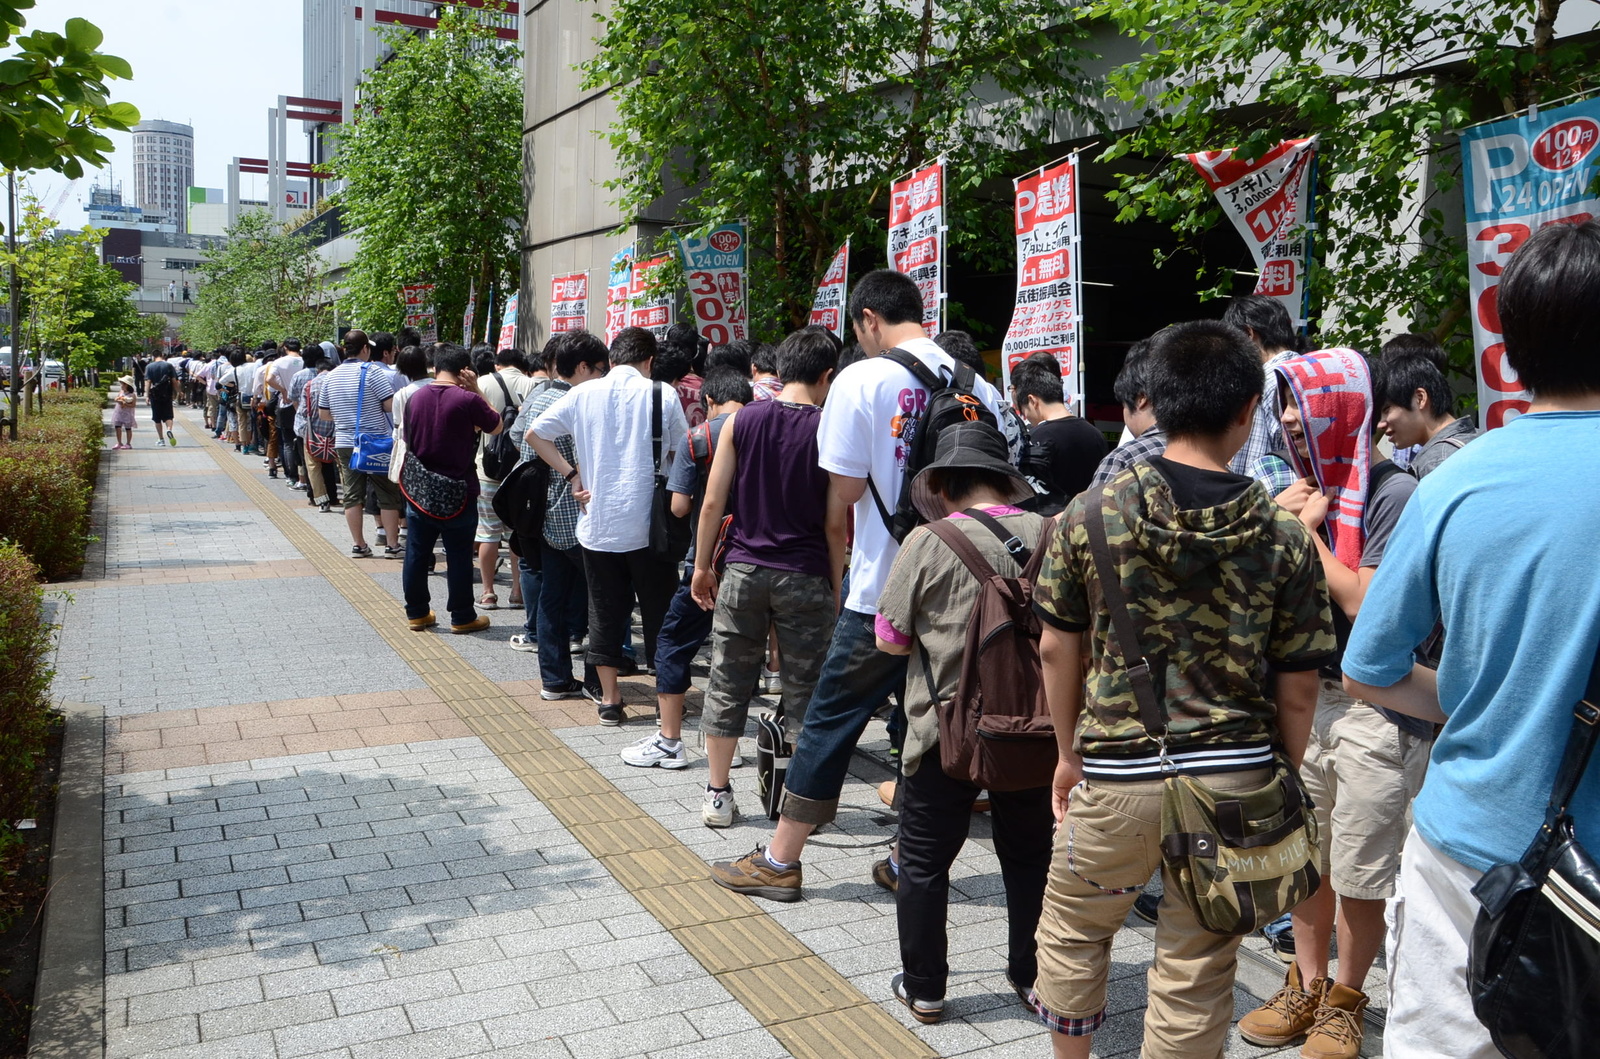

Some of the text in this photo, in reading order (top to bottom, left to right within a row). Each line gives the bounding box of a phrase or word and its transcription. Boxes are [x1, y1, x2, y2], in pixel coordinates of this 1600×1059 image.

[1540, 126, 1593, 153] 100円
[1552, 148, 1581, 168] 12分
[1470, 134, 1529, 214] P
[1499, 168, 1590, 213] 24 OPEN
[696, 254, 739, 267] 24 OPEN
